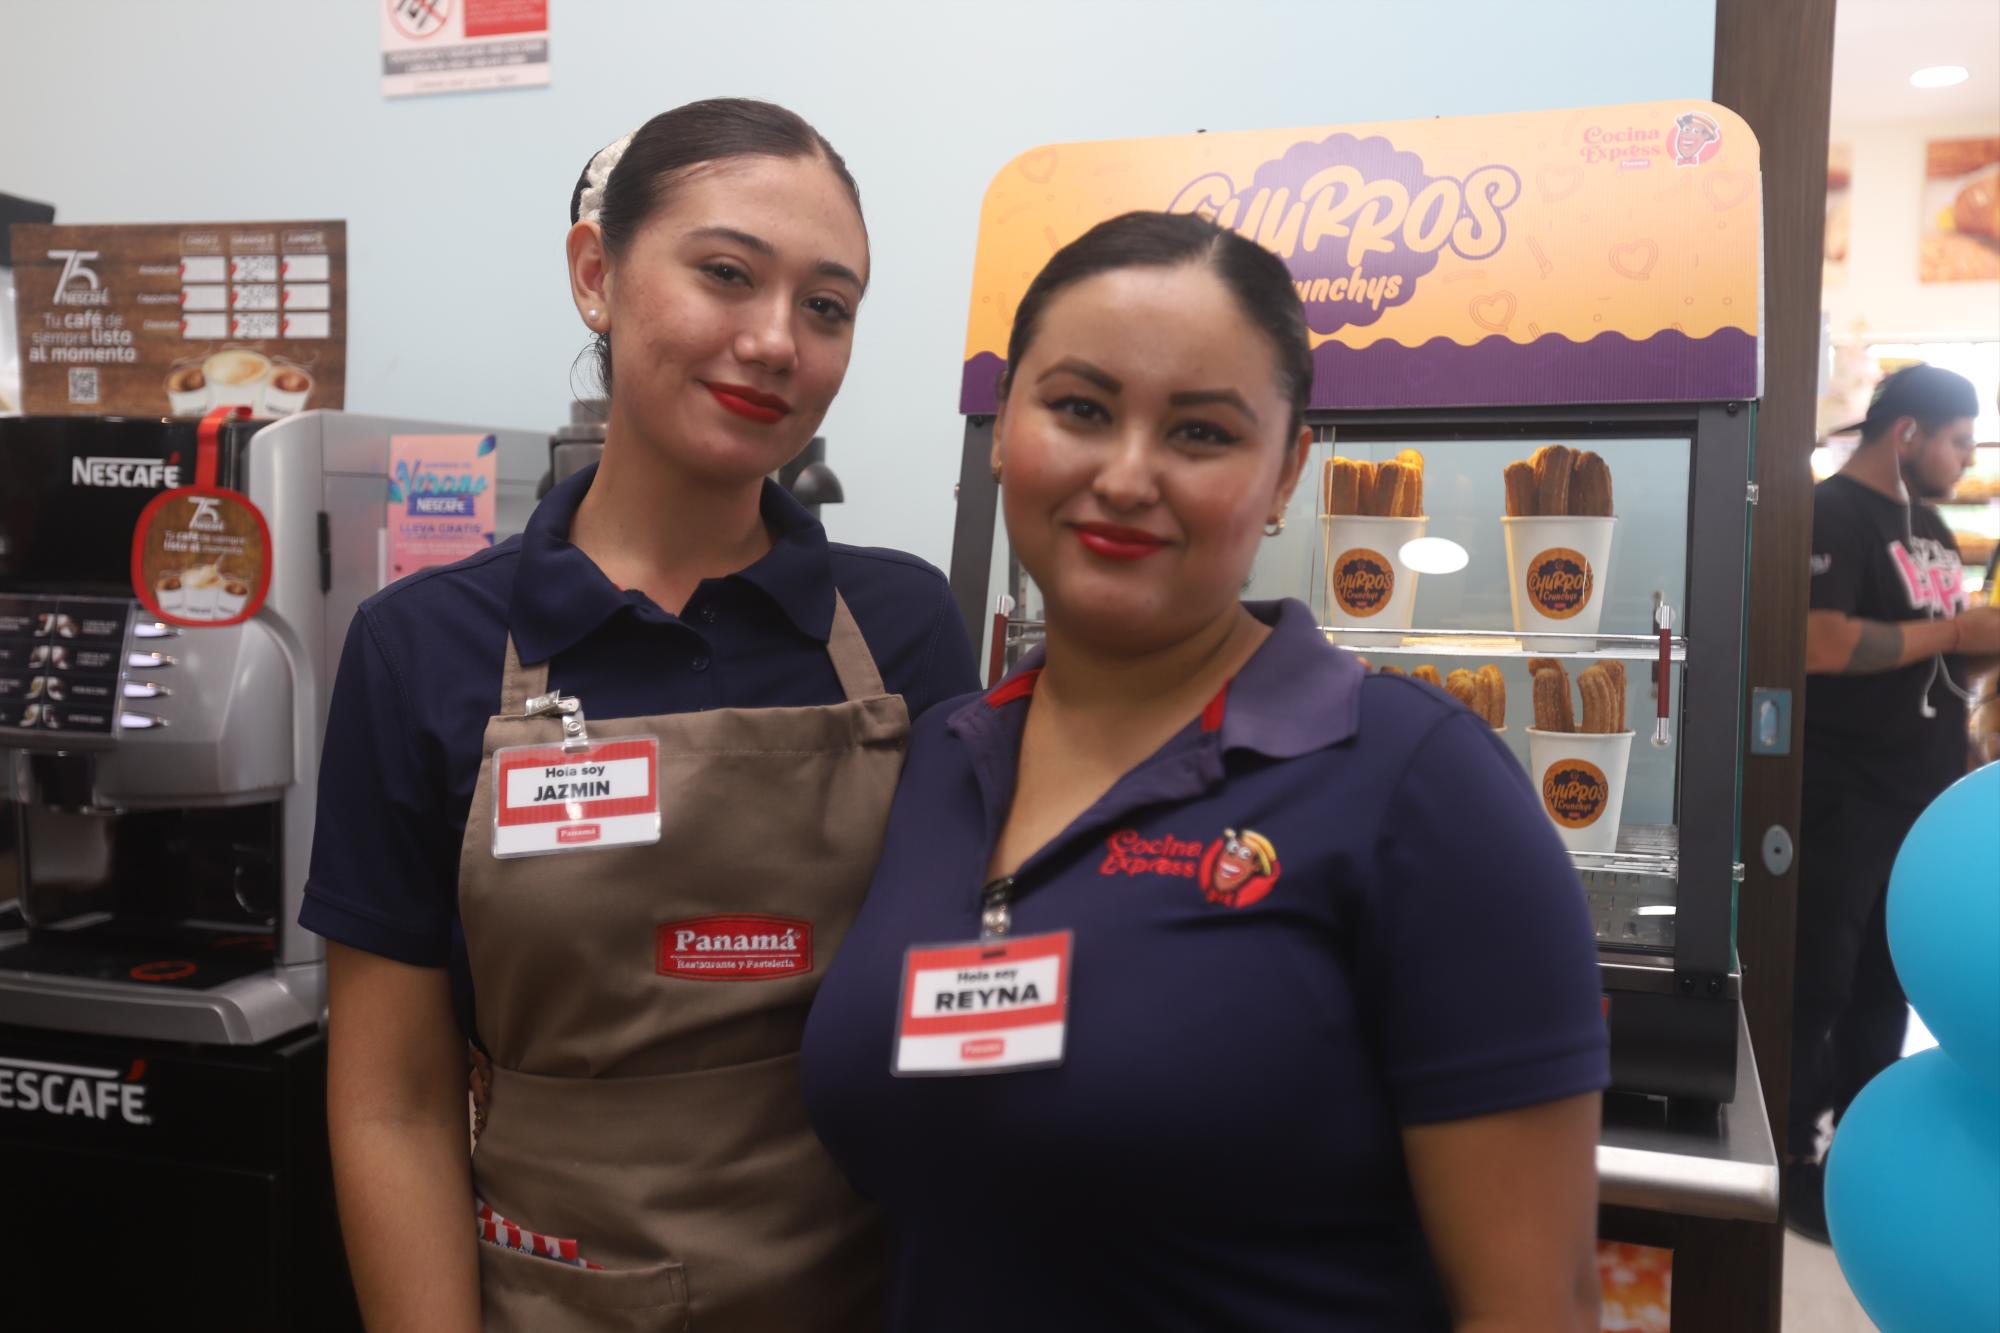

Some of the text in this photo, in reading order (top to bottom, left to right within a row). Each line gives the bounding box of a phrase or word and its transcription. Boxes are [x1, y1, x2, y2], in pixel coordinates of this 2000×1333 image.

[1584, 127, 1660, 144] Cocina
[1580, 144, 1661, 164] Express
[48, 250, 99, 305] 75
[1293, 265, 1403, 311] unchys
[43, 312, 61, 329] Tu
[64, 309, 102, 329] café
[105, 313, 123, 328] de
[31, 328, 133, 345] siempre listo
[29, 345, 136, 363] al momento
[72, 451, 180, 489] NESCAFÉ
[187, 496, 220, 529] 75
[416, 496, 465, 513] NESCAFÉ
[400, 522, 482, 534] LLEVA GRATIS
[581, 765, 606, 777] soy
[533, 780, 610, 801] JAZMIN
[1107, 829, 1202, 857] Cocina
[1099, 852, 1195, 877] Express
[674, 928, 798, 952] Panamá
[676, 958, 795, 970] Restaurante y Pastelería
[957, 969, 1018, 984] Hola soy
[934, 983, 1040, 1011] REYNA
[0, 1057, 151, 1126] ESCAFÉ
